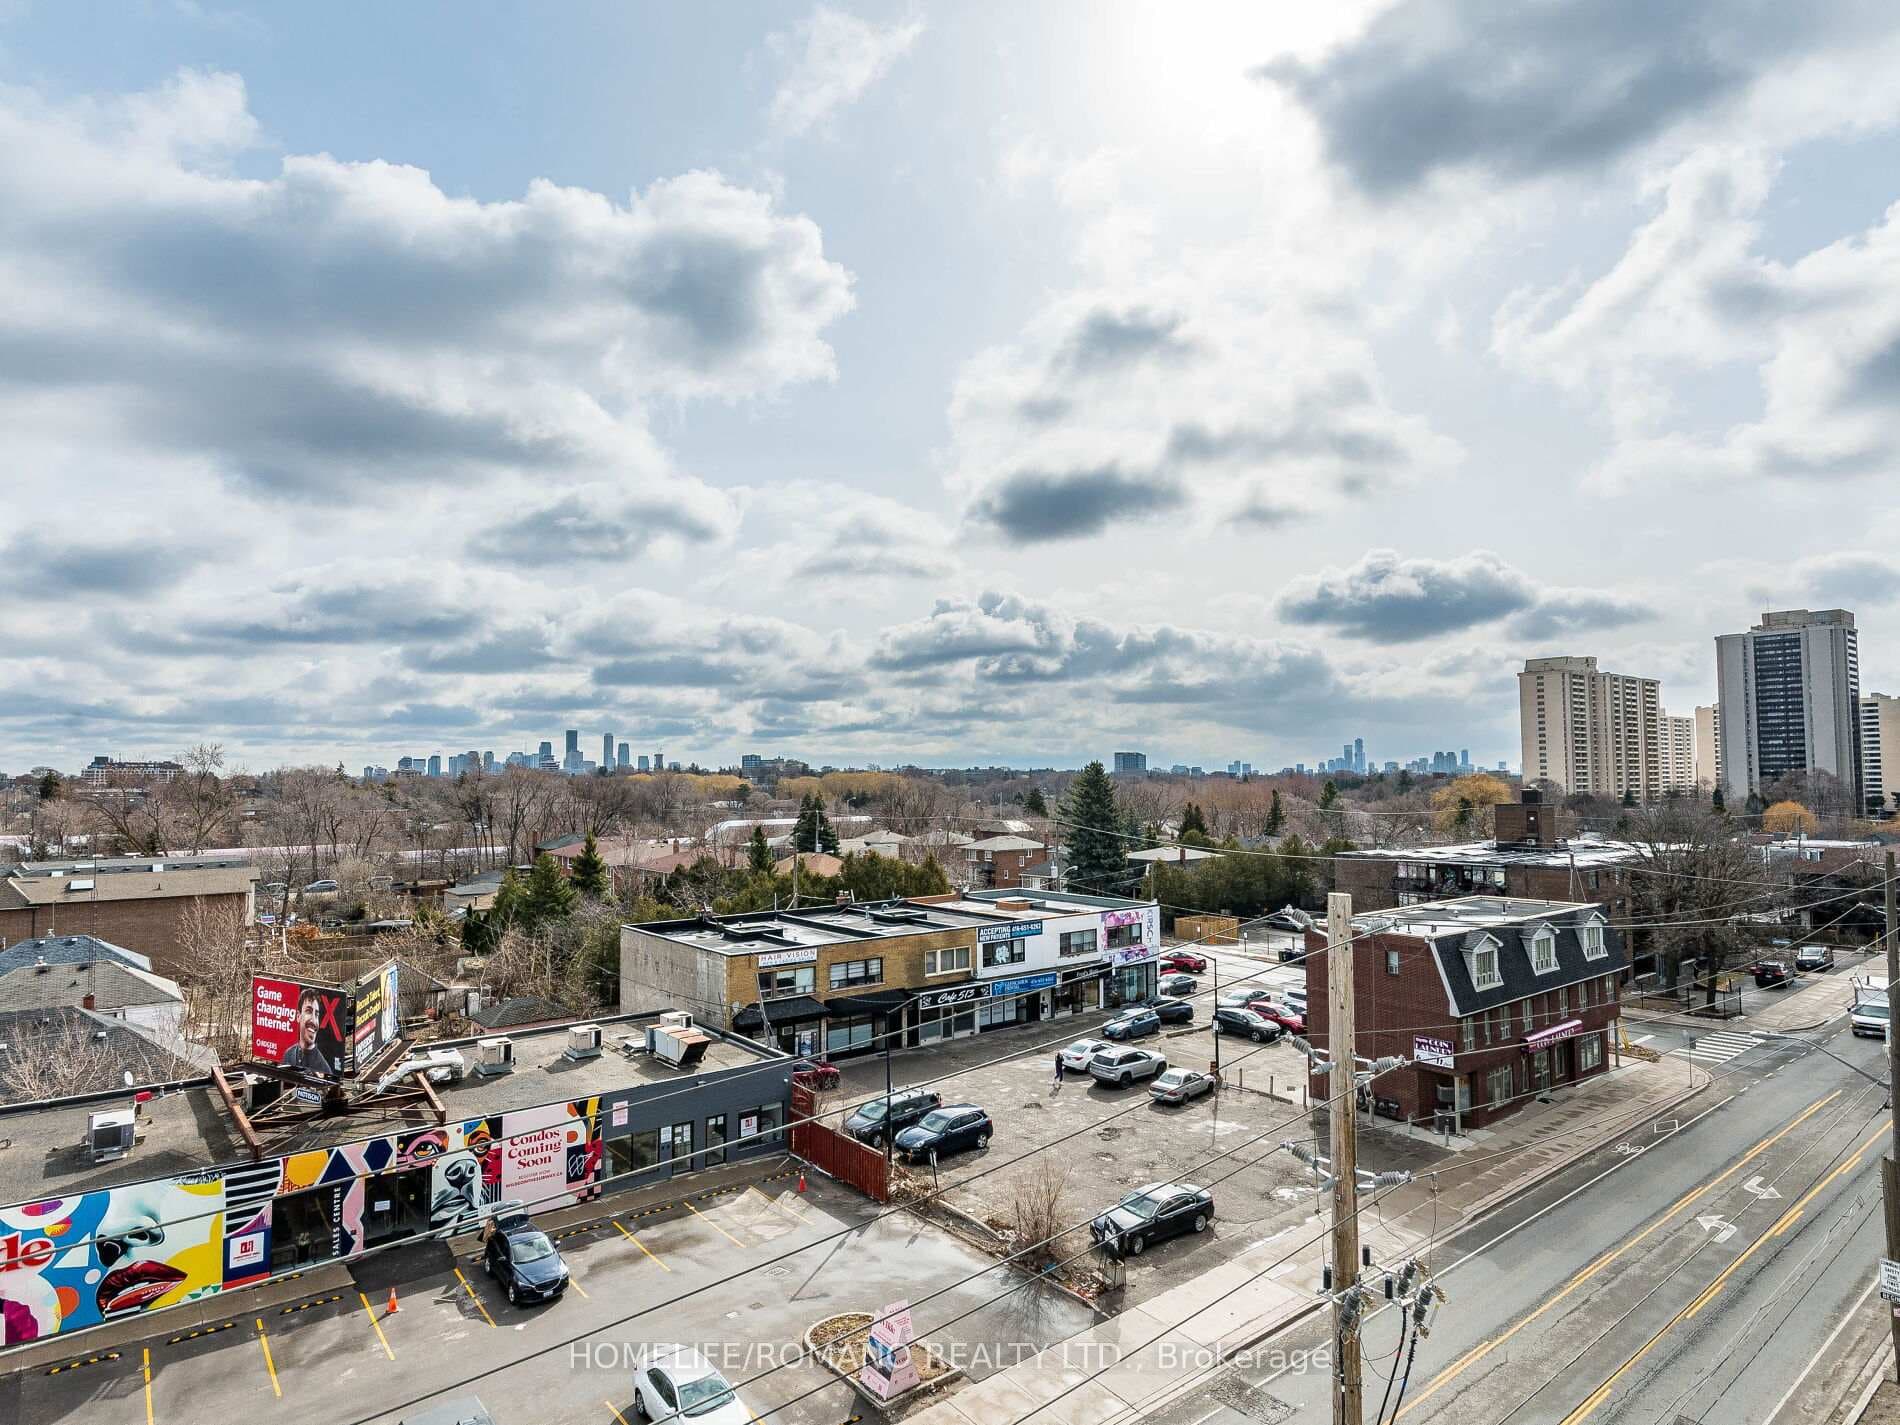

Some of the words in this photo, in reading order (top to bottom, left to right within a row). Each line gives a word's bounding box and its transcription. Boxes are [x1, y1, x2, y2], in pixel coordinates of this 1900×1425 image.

[979, 925, 1011, 936] ACCEPTING
[1146, 908, 1154, 944] KIRSCH
[979, 934, 990, 942] NEW
[990, 932, 1011, 941] PATIENTS
[761, 953, 782, 961] HAIR
[787, 949, 816, 958] VISION
[257, 985, 283, 1002] Game
[937, 992, 958, 1004] Cafe
[958, 988, 976, 1001] 513
[256, 1001, 297, 1021] changing
[256, 1013, 294, 1033] internet.
[297, 1089, 320, 1102] PATTISON
[509, 1129, 560, 1147] Condos
[507, 1139, 562, 1159] Coming
[517, 1155, 552, 1170] Soon
[332, 1187, 341, 1223] CENTRE
[332, 1226, 341, 1257] SALES
